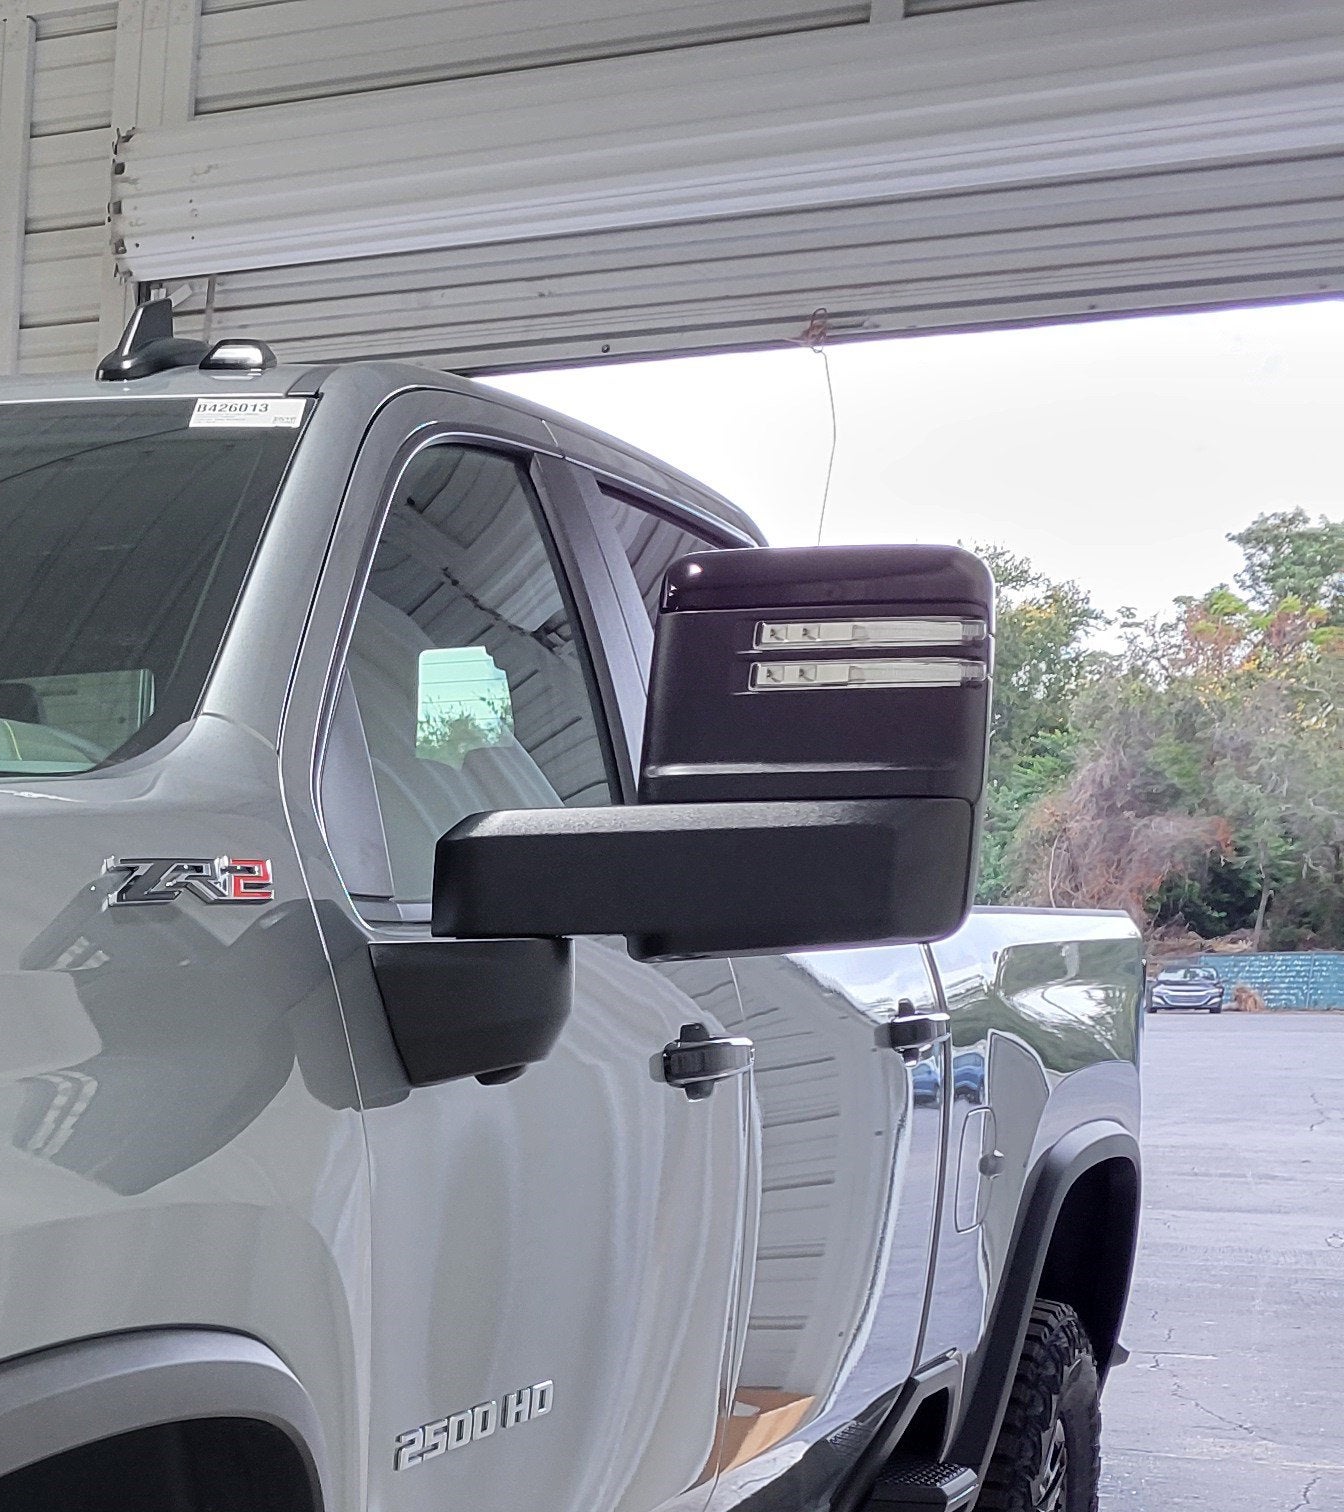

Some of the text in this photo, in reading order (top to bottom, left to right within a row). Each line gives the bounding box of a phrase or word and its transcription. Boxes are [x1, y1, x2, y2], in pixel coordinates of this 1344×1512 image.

[197, 403, 269, 413] B426013
[102, 856, 274, 906] ZR2
[393, 1379, 554, 1472] 2500 HD
